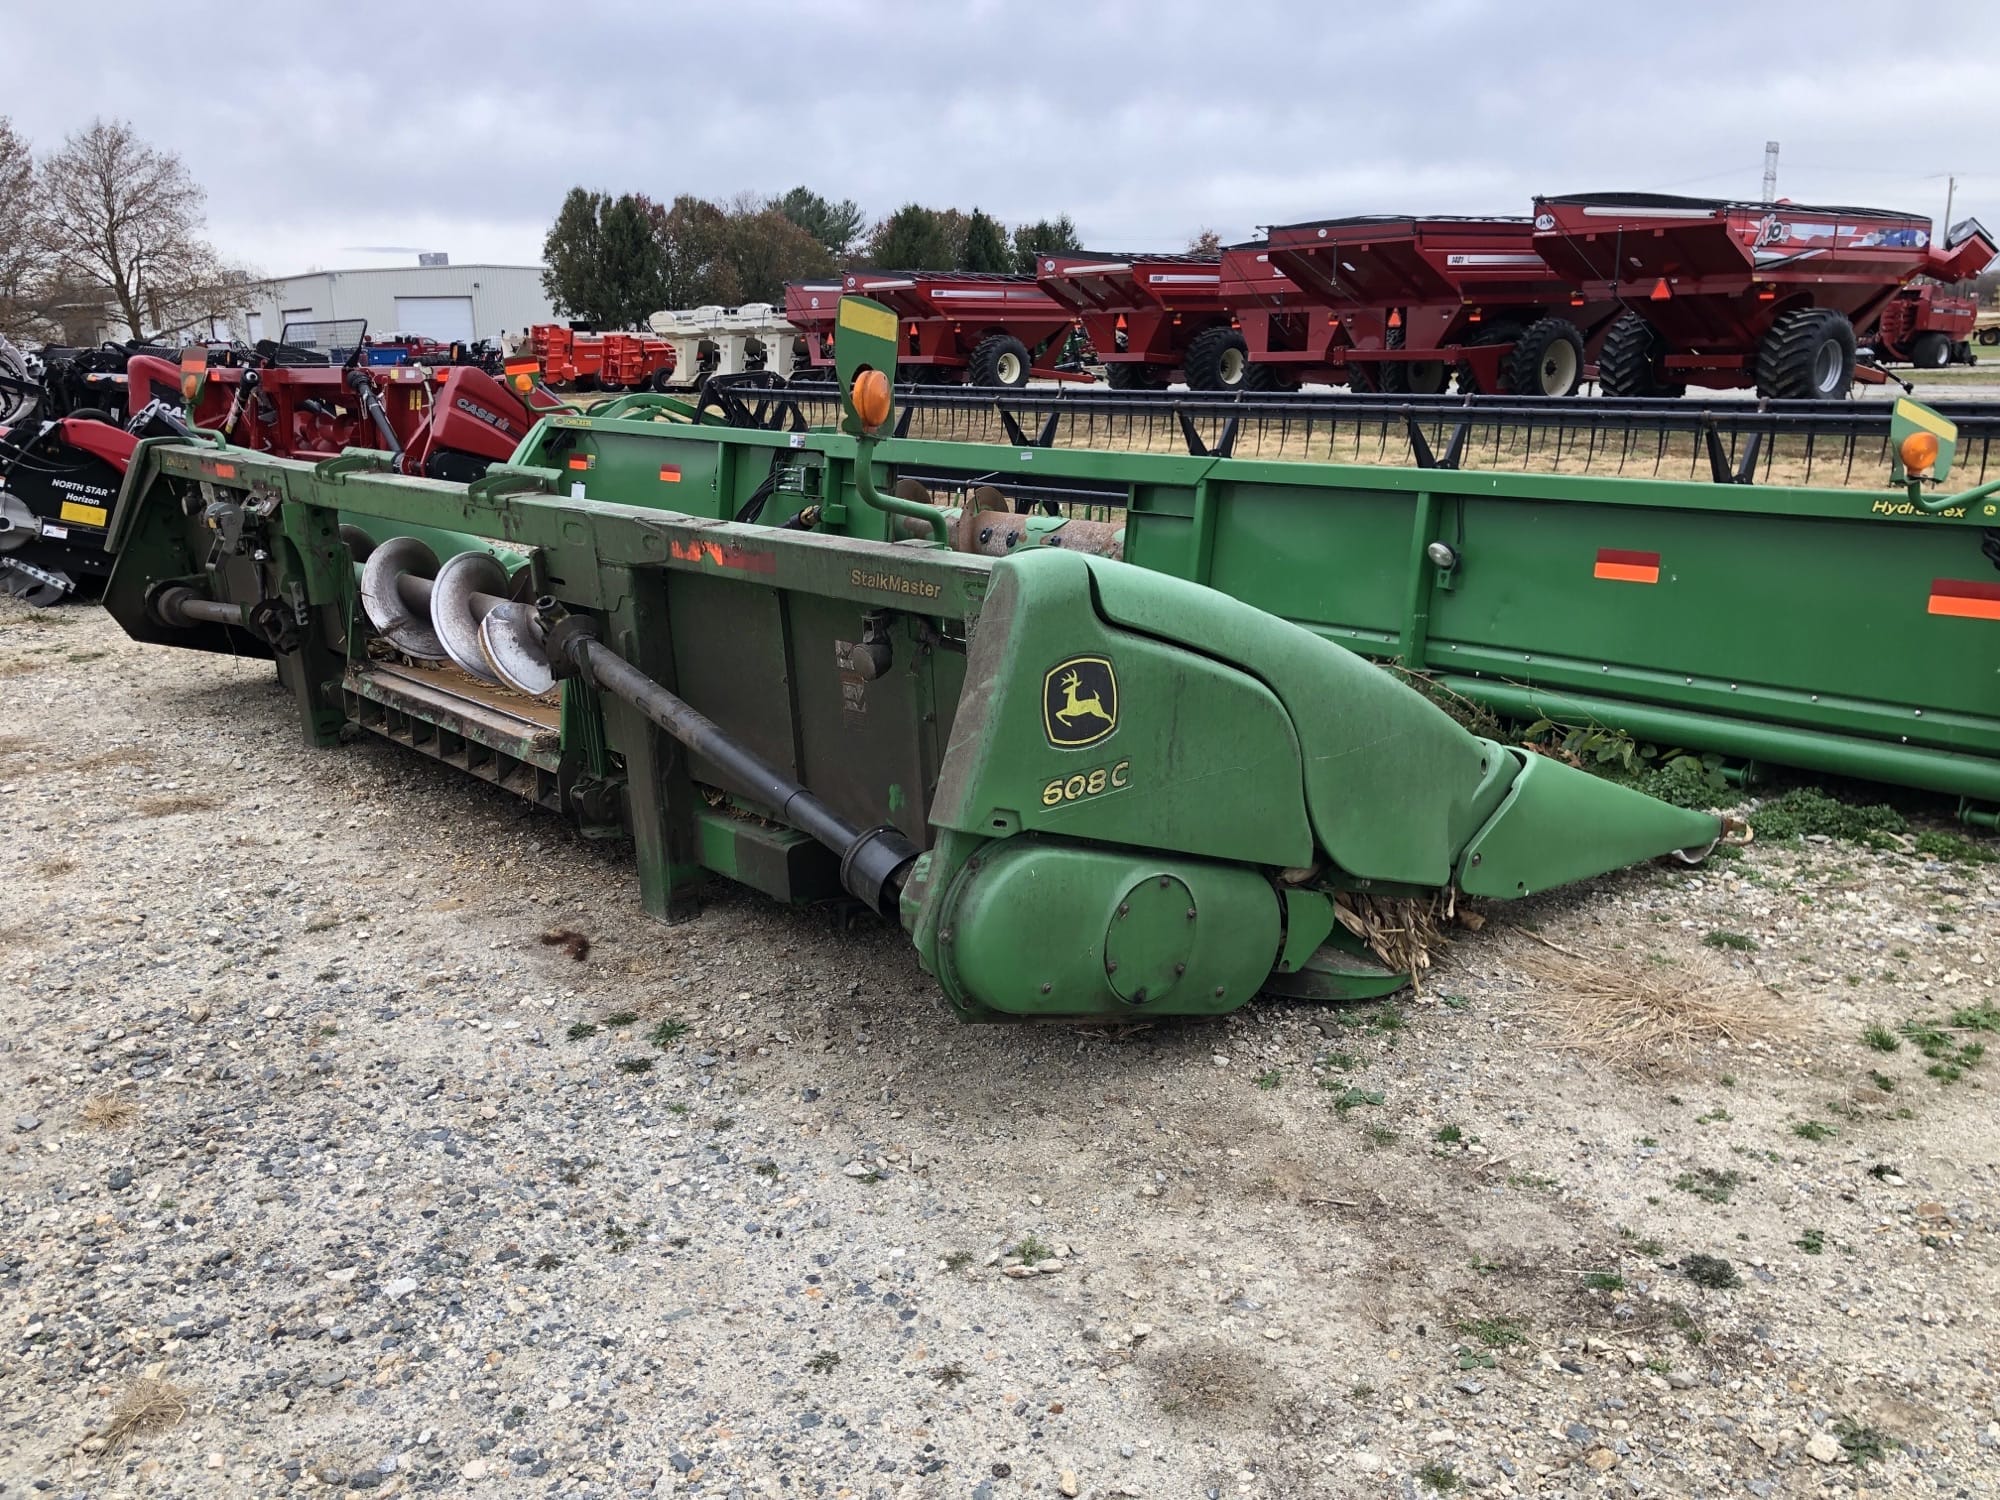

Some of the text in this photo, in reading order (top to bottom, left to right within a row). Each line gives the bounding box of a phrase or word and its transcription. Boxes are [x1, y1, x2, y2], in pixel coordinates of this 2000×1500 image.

[457, 398, 497, 424] CASE
[51, 479, 109, 497] NORTH STAR
[66, 492, 100, 506] Horizon
[851, 568, 941, 599] StalkMaster
